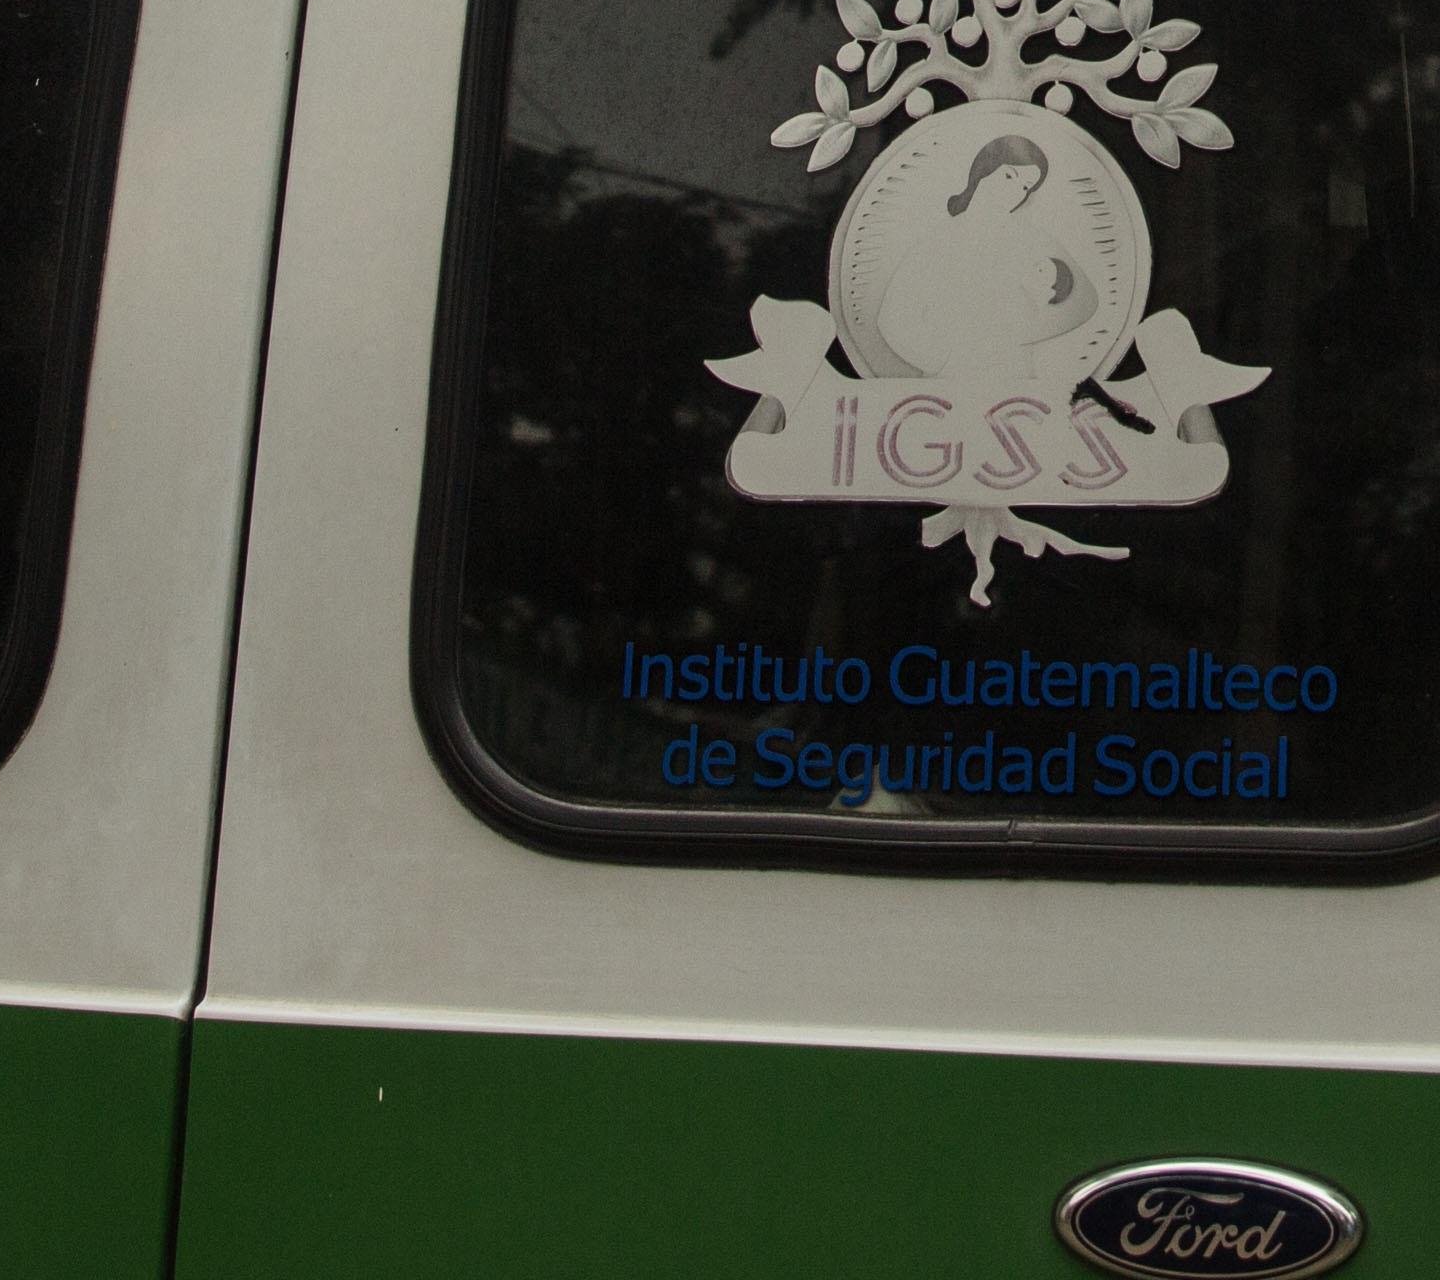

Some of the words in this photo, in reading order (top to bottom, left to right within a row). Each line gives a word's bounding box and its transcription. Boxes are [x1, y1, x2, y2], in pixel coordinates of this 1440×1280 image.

[829, 392, 1140, 490] IGSS
[621, 642, 871, 705] Instituto
[889, 644, 1338, 715] Guatemalteco
[662, 724, 736, 787] de
[752, 727, 1078, 806] Seguridad
[1093, 735, 1289, 799] Social
[1119, 1187, 1287, 1259] Ford
